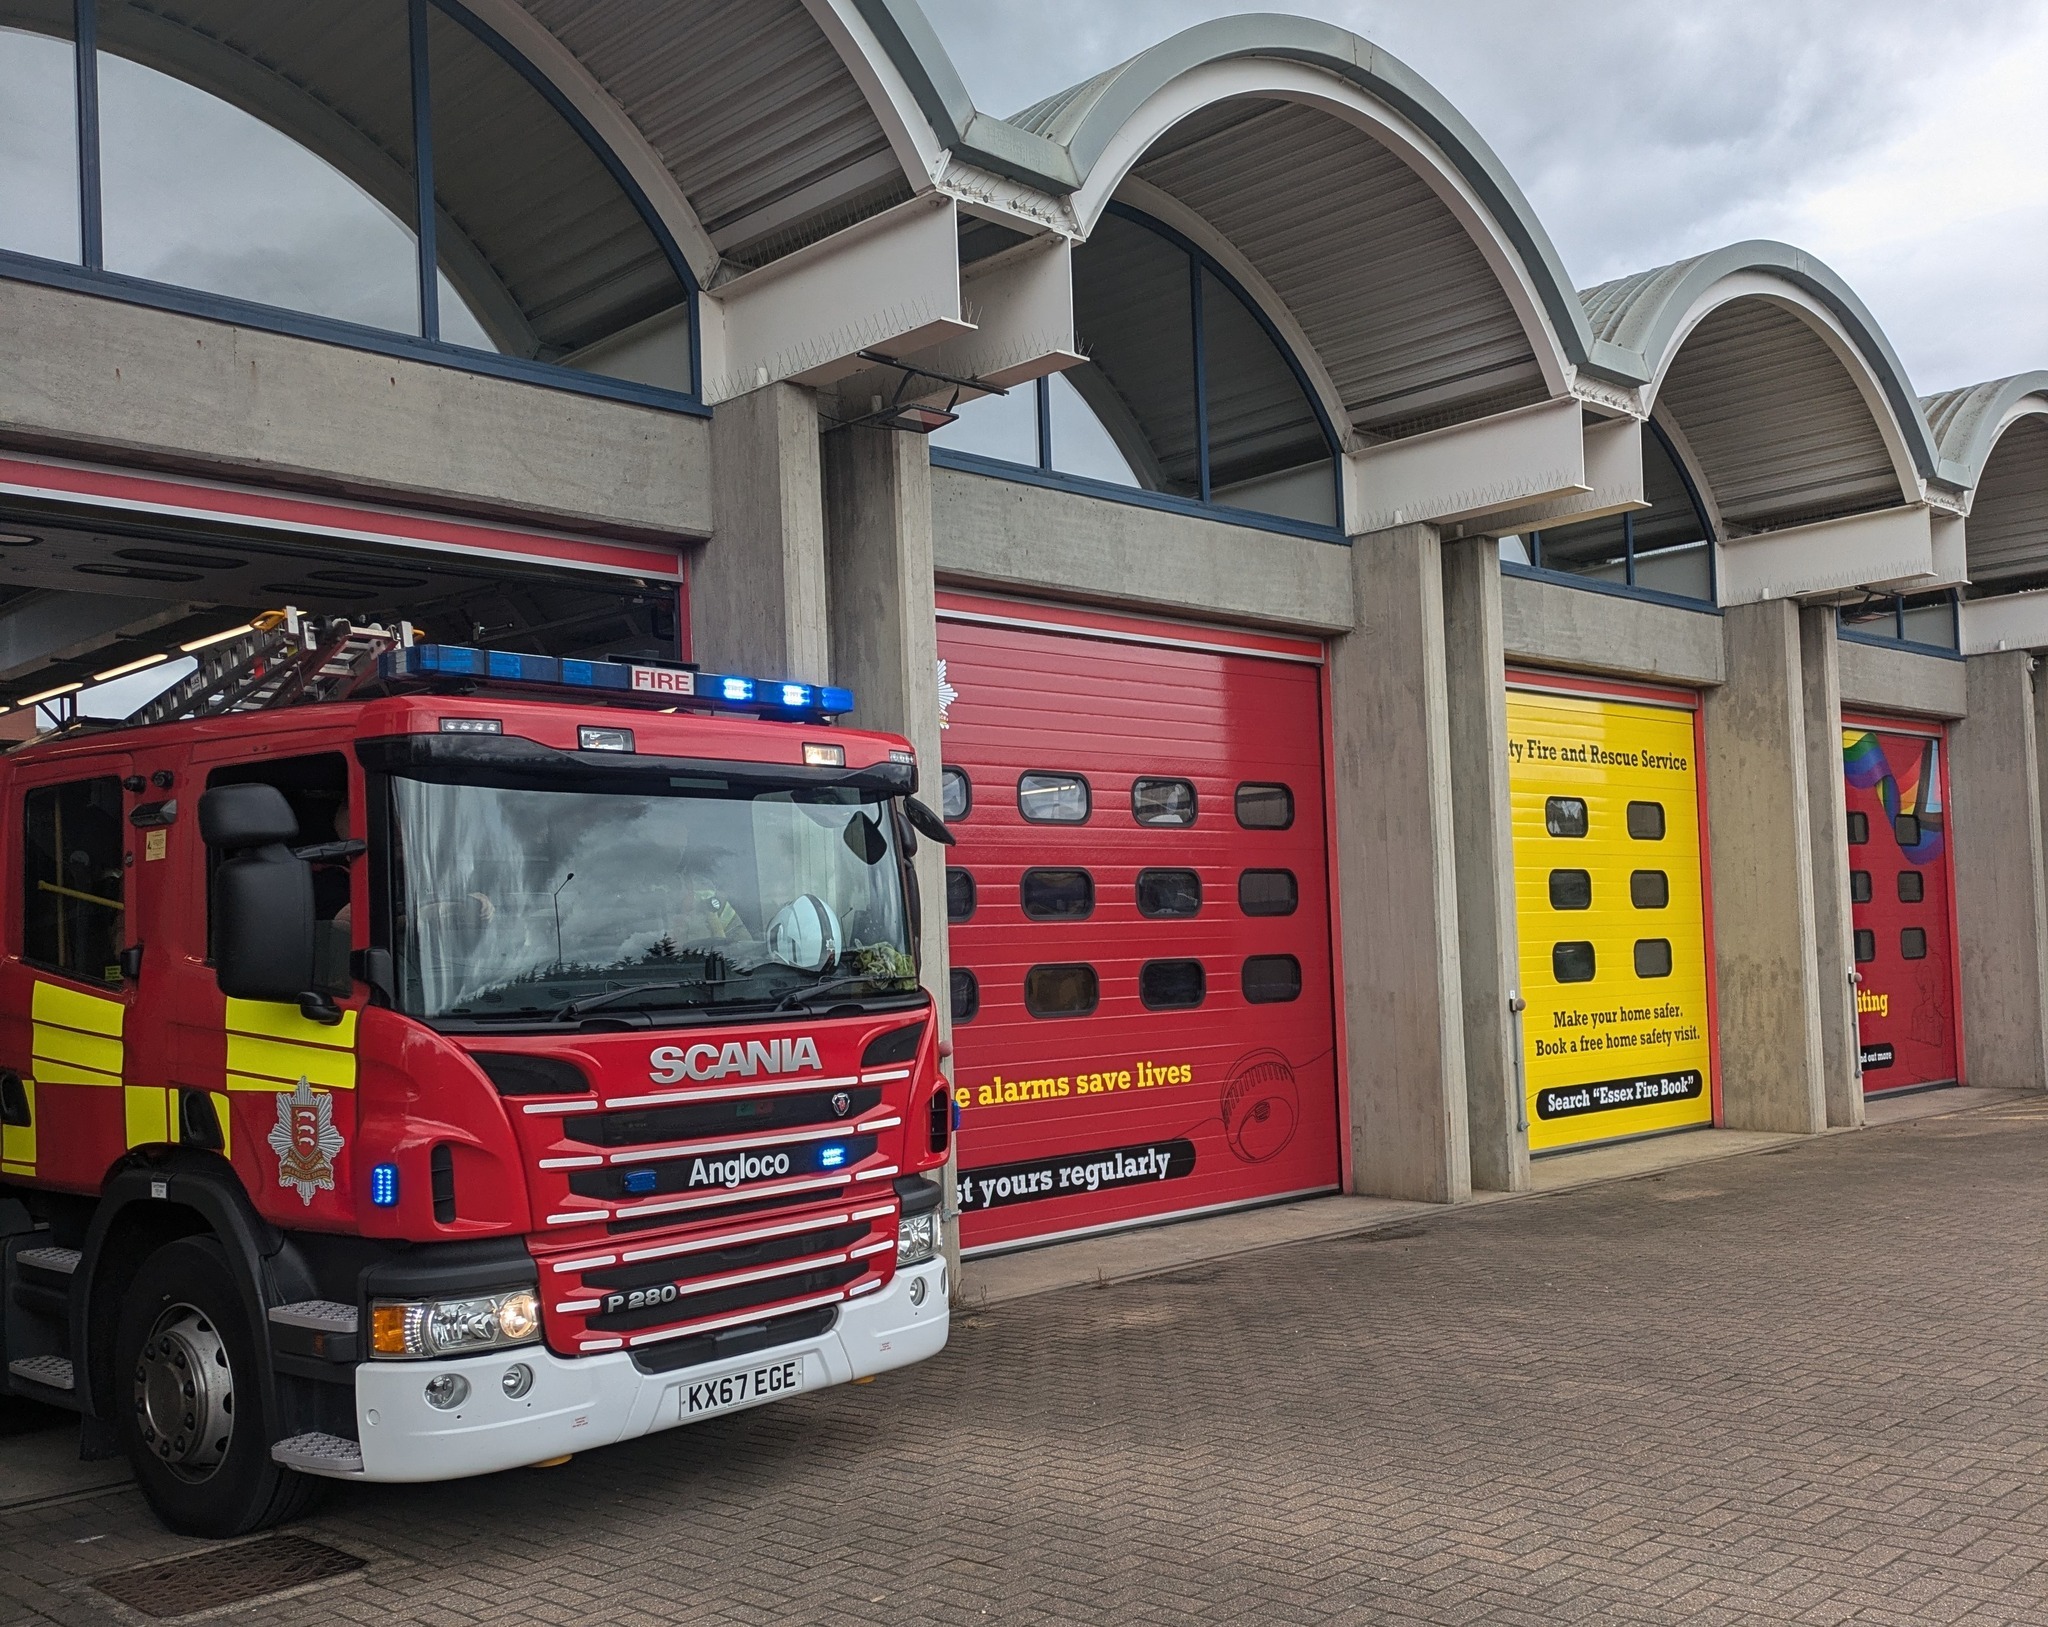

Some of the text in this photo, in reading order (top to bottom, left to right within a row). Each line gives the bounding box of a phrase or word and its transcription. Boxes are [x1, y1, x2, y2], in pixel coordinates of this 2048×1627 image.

[635, 670, 690, 691] FIRE
[1527, 739, 1557, 760] Fire
[1560, 746, 1587, 763] and
[1590, 744, 1638, 767] Rescue
[1641, 749, 1687, 771] Service
[1553, 1002, 1683, 1029] Make your home safer.
[1535, 1025, 1700, 1056] Book a free home safety visit.
[649, 1036, 823, 1084] SCANIA
[978, 1076, 1069, 1106] alarms
[1077, 1070, 1131, 1095] save
[1137, 1061, 1192, 1088] lives
[1548, 1089, 1590, 1112] Search
[1635, 1081, 1658, 1099] Fire
[688, 1152, 790, 1188] Angloco
[979, 1170, 1053, 1208] yours
[1059, 1148, 1171, 1190] regularly
[607, 1285, 677, 1313] P 280
[689, 1362, 796, 1412] KX67 EGE
